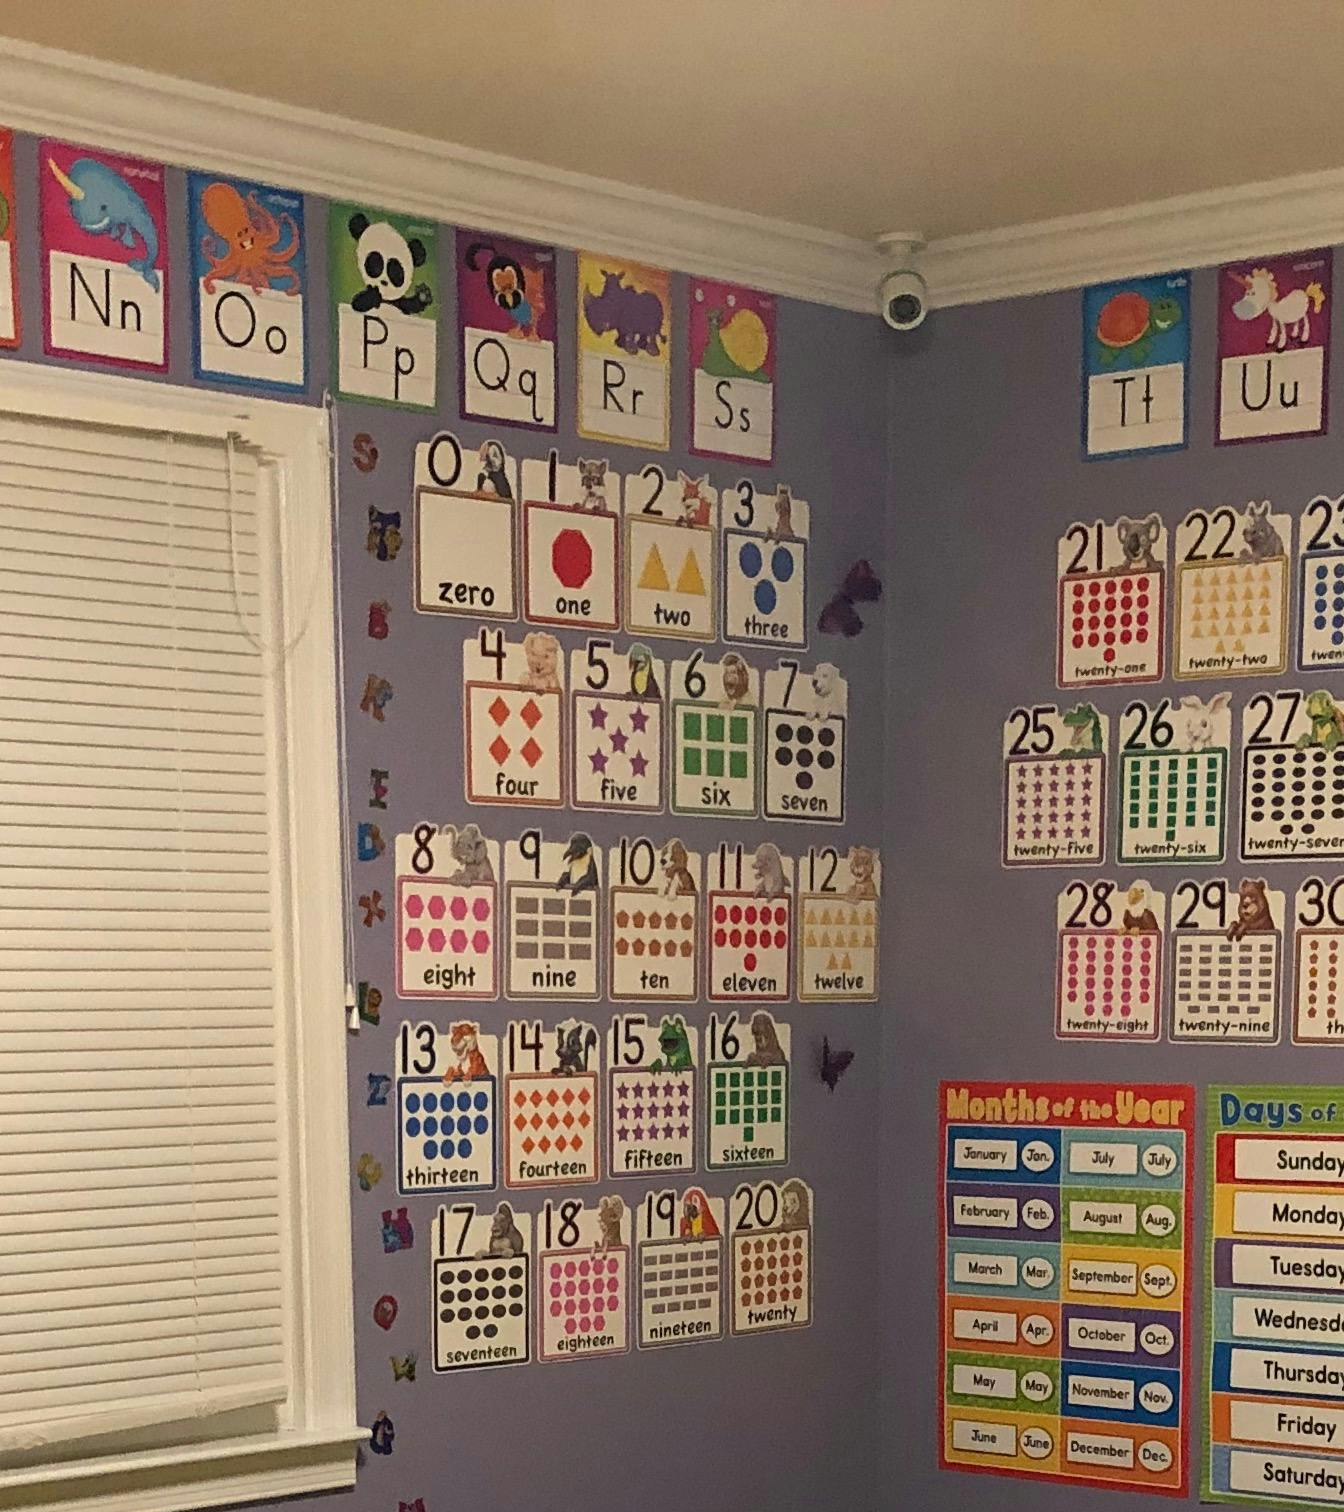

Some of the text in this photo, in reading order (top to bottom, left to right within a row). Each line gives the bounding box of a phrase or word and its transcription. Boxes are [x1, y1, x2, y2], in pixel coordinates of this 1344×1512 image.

[70, 262, 141, 331] Nn
[215, 291, 287, 354] Oo
[363, 315, 415, 399] Pp
[474, 338, 543, 422] Qq
[603, 359, 644, 415] Rr
[1241, 359, 1299, 411] Uu
[715, 381, 751, 432] Ss
[1113, 375, 1154, 427] Tt
[428, 434, 461, 486] 0
[548, 450, 556, 502] 1
[642, 466, 664, 516] 2
[734, 480, 754, 527] 3
[1066, 525, 1104, 573] 21
[1183, 510, 1236, 561] 22
[439, 582, 494, 607] zero
[556, 598, 591, 616] one
[654, 604, 690, 627] two
[744, 616, 788, 639] three
[480, 629, 506, 681] 4
[586, 640, 612, 689] 5
[1189, 654, 1268, 669] twenty-two
[685, 651, 706, 698] 6
[1074, 661, 1146, 677] twenty-one
[779, 662, 798, 706] 7
[1009, 706, 1056, 754] 25
[1124, 702, 1174, 749] 26
[1250, 692, 1300, 745] 27
[496, 772, 539, 797] four
[601, 778, 637, 801] five
[701, 783, 731, 806] six
[781, 794, 828, 812] seven
[411, 825, 435, 874] 8
[520, 831, 542, 879] 9
[618, 837, 655, 885] 10
[1014, 841, 1093, 857] twenty-five
[1134, 840, 1206, 856] twenty-six
[720, 843, 743, 889] 11
[809, 848, 837, 892] 12
[1065, 882, 1114, 928] 28
[1176, 881, 1226, 928] 29
[423, 964, 476, 990] eight
[532, 967, 576, 987] nine
[641, 971, 669, 989] ten
[723, 973, 777, 992] eleven
[815, 973, 863, 990] twelve
[710, 1014, 740, 1060] 16
[1066, 1017, 1149, 1034] twenty-eight
[1178, 1018, 1270, 1036] twenty-nine
[401, 1024, 436, 1074] 13
[508, 1021, 543, 1071] 14
[612, 1018, 644, 1066] 15
[947, 1088, 1185, 1125] Months of the Year
[1220, 1092, 1303, 1128] Days
[1311, 1102, 1337, 1122] of
[625, 1149, 682, 1168] fifteen
[722, 1145, 774, 1161] sixteen
[963, 1147, 1007, 1162] January
[1092, 1151, 1172, 1169] July July
[406, 1166, 479, 1184] thirteen
[519, 1160, 587, 1179] fourteen
[647, 1194, 676, 1237] 19
[736, 1185, 779, 1230] 20
[960, 1204, 1050, 1221] February Feb.
[1083, 1211, 1172, 1229] August Aug.
[438, 1207, 475, 1256] 17
[545, 1202, 581, 1248] 18
[968, 1262, 1002, 1275] March
[1072, 1268, 1173, 1287] September Sept.
[747, 1305, 798, 1325] twenty
[972, 1319, 998, 1333] April
[649, 1320, 711, 1339] nineteen
[1078, 1327, 1126, 1341] October
[446, 1344, 517, 1363] seventeen
[556, 1334, 614, 1353] eighteen
[973, 1374, 1048, 1395] May May
[1072, 1384, 1131, 1399] November
[971, 1429, 1049, 1449] June June
[1277, 1413, 1337, 1442] Friday
[1071, 1441, 1130, 1457] December
